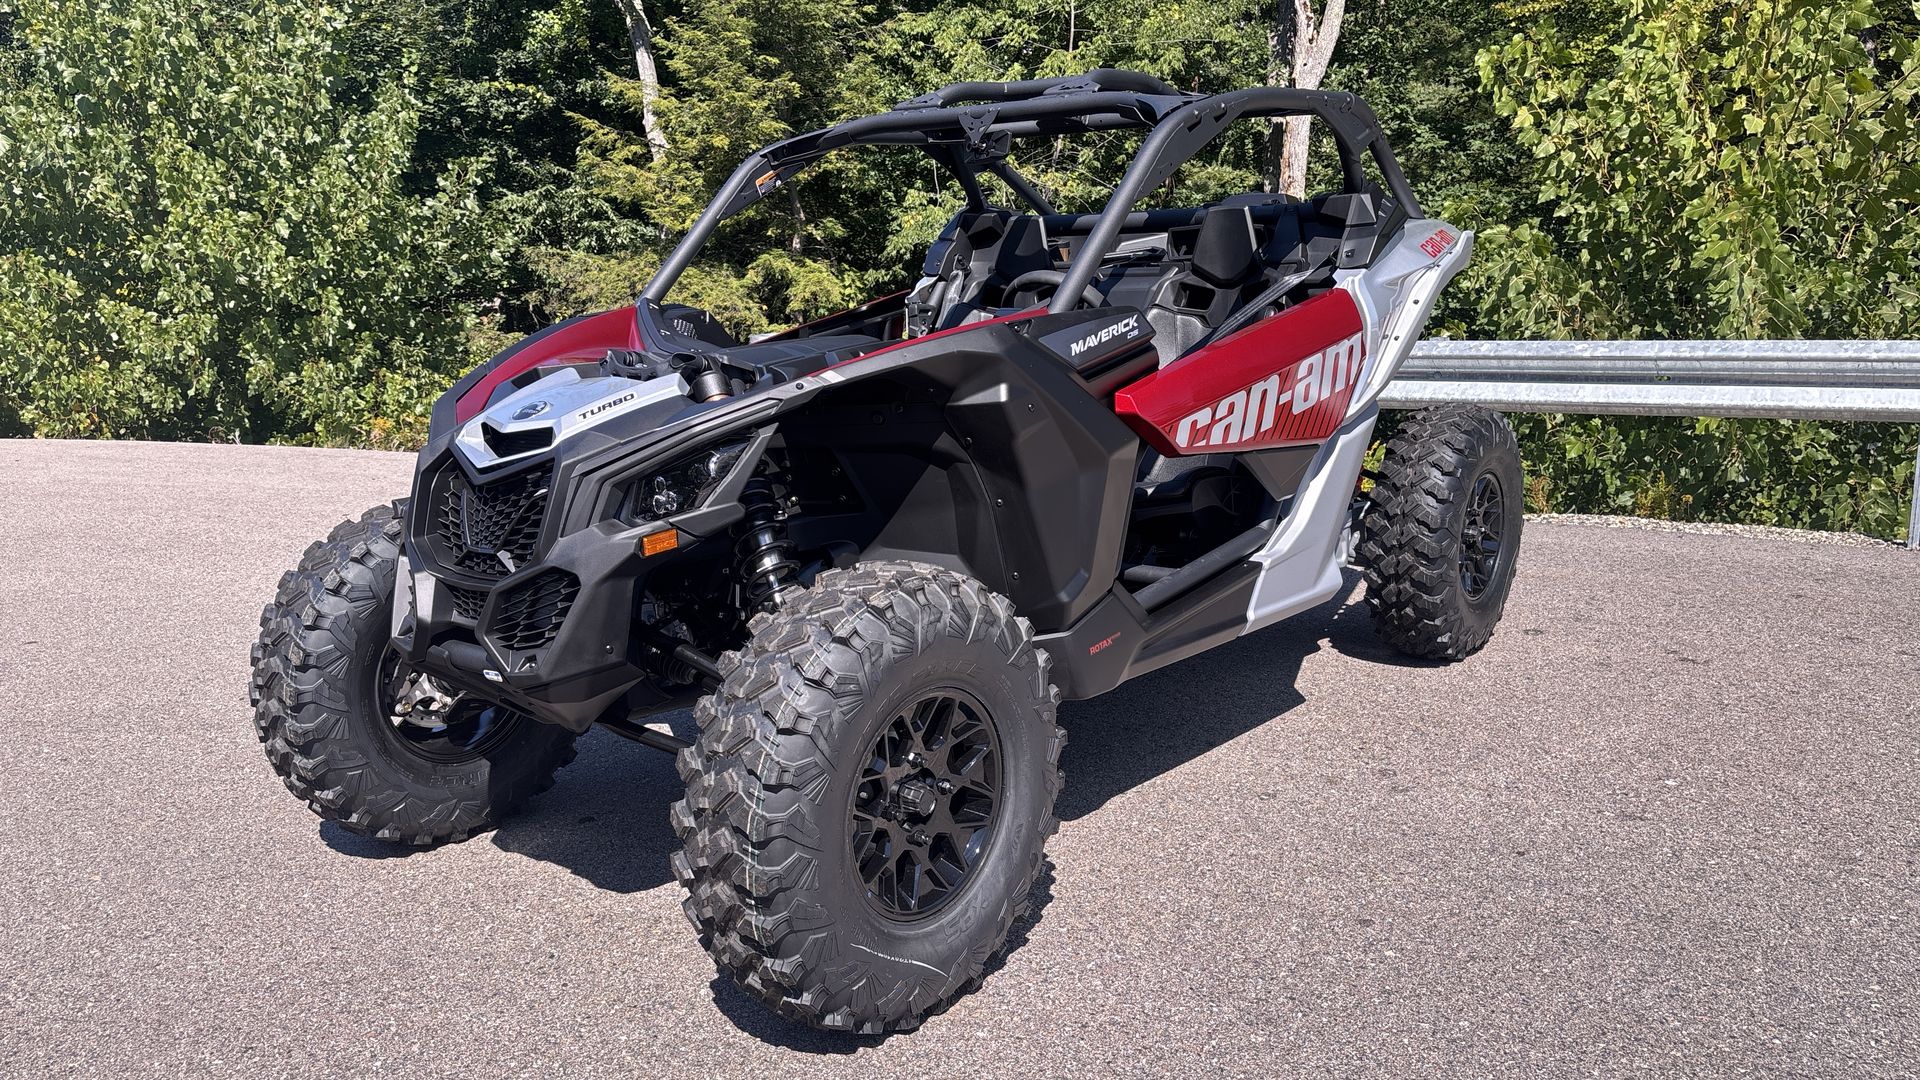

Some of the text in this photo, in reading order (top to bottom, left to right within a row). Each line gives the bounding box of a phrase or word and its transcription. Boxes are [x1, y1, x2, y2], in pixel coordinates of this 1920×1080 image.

[1419, 229, 1456, 258] can-am
[1070, 314, 1138, 356] MAVERICK
[1176, 332, 1362, 448] can-am
[578, 393, 635, 419] TURBO
[1089, 637, 1113, 656] ROTAX
